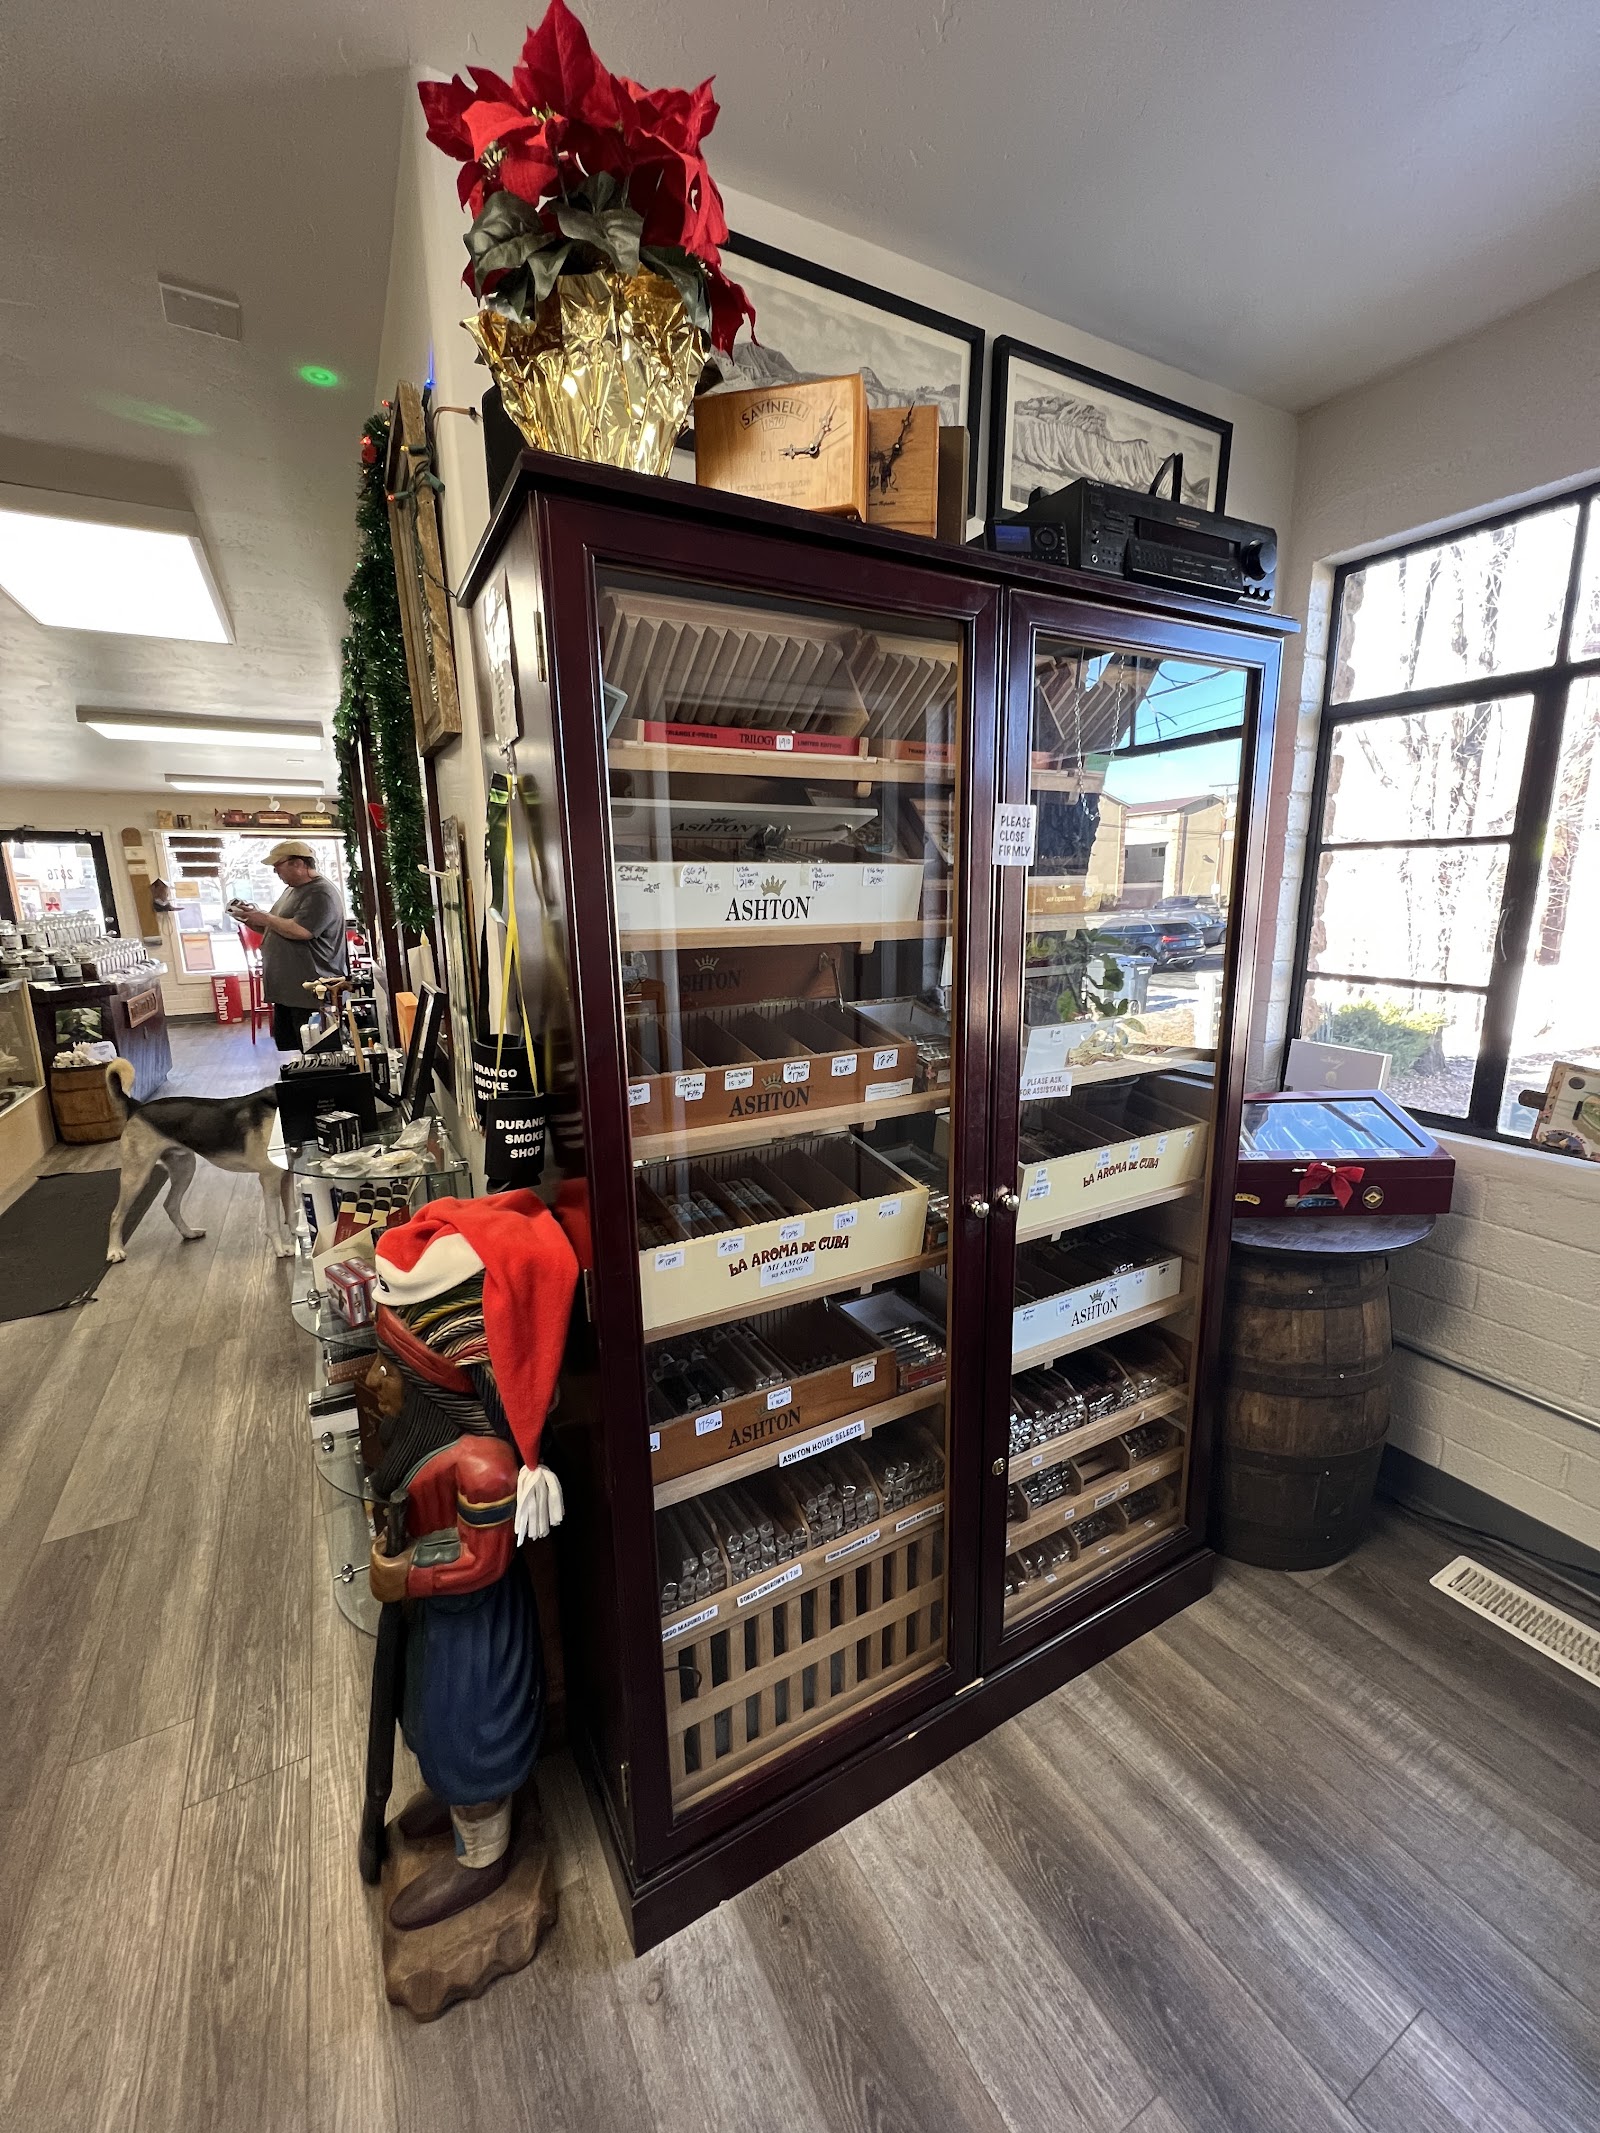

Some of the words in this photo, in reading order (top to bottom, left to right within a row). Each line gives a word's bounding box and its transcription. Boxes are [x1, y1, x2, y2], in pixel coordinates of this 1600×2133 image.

[741, 400, 810, 426] SAVINELLI
[740, 733, 777, 748] TRILOGY
[671, 823, 753, 832] ASHTON
[1000, 815, 1031, 828] PLEASE
[999, 831, 1025, 843] CLOSE
[998, 845, 1031, 858] FIRMLY
[725, 896, 811, 921] ASHTON
[213, 978, 229, 1021] Marlboro
[473, 1061, 518, 1078] URANGO
[474, 1075, 509, 1091] SMOKE
[1026, 1076, 1049, 1087] PLEASE
[1049, 1075, 1063, 1085] ASK
[1019, 1087, 1031, 1097] FOR
[1032, 1084, 1069, 1096] ASSISTANCE
[728, 1086, 811, 1118] ASHTON
[495, 1115, 546, 1130] DURANG
[504, 1130, 544, 1144] SMOKE
[509, 1145, 541, 1159] SHOP
[1083, 1175, 1095, 1188] LA
[1097, 1161, 1127, 1181] AROMA
[1128, 1160, 1138, 1171] DE
[1139, 1157, 1159, 1170] CUBA
[728, 1258, 749, 1277] LA
[751, 1241, 798, 1269] AROMA
[801, 1240, 817, 1254] DE
[818, 1235, 850, 1251] CUBA
[766, 1262, 779, 1273] MI
[781, 1255, 809, 1269] AMOR
[780, 1265, 804, 1278] RATING
[1071, 1295, 1119, 1327] ASHTON
[728, 1406, 801, 1450] ASHTON
[782, 1446, 811, 1464] ASHTON
[812, 1436, 834, 1452] HOUSE
[835, 1423, 862, 1442] SELECTS
[661, 1628, 677, 1640] ORDO
